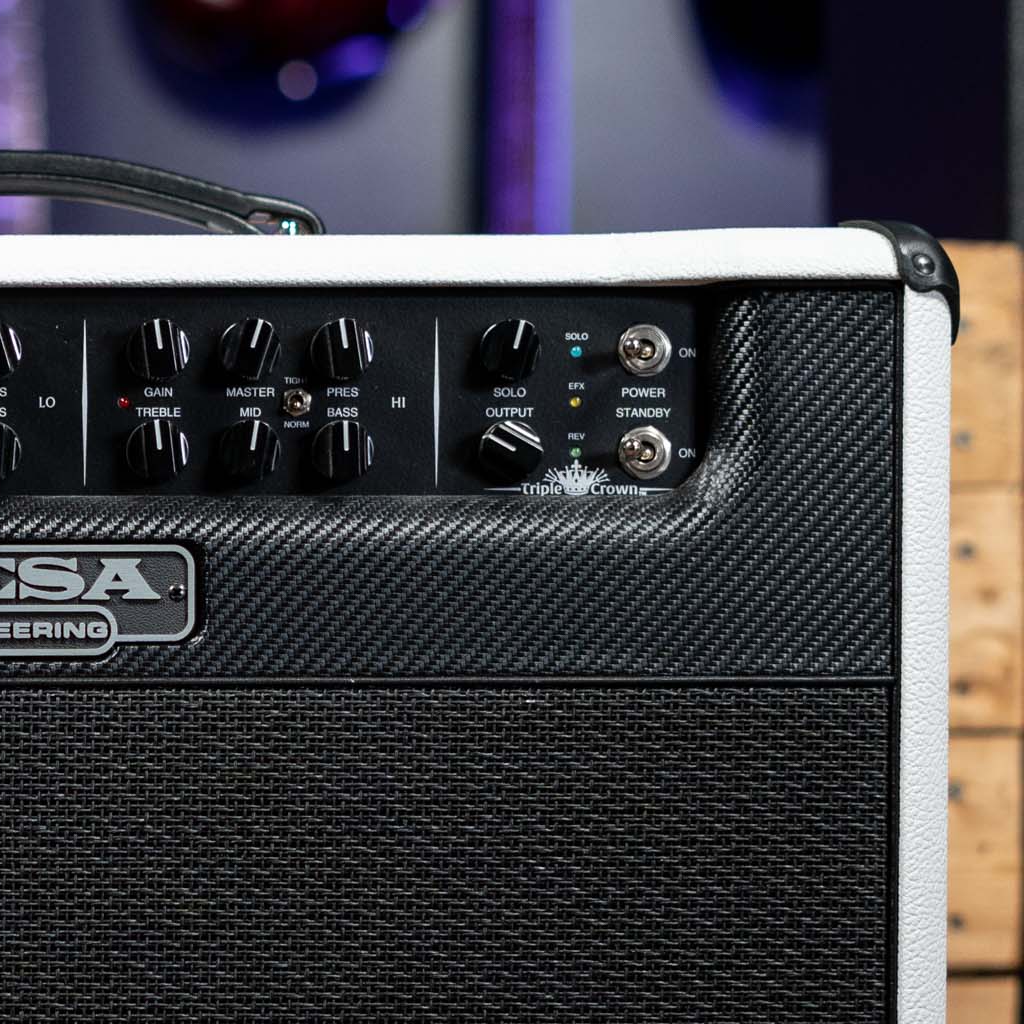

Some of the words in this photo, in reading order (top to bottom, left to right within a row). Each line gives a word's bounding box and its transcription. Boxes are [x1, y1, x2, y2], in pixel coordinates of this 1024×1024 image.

[564, 332, 589, 341] SOLO
[678, 348, 696, 358] ON
[143, 386, 173, 398] GAIN
[226, 386, 275, 397] MASTER
[326, 386, 359, 398] PRES
[568, 382, 585, 390] EFX
[493, 386, 527, 399] SOLO
[621, 387, 666, 399] POWER
[38, 396, 56, 409] LO
[391, 396, 406, 409] HI
[135, 406, 182, 418] TREBLE
[239, 406, 262, 418] MID
[326, 406, 359, 418] BASS
[485, 407, 534, 418] OUTPUT
[615, 407, 672, 419] STANDBY
[283, 420, 311, 429] NORM
[567, 432, 586, 441] REV
[678, 447, 696, 458] ON
[520, 481, 563, 497] Triple
